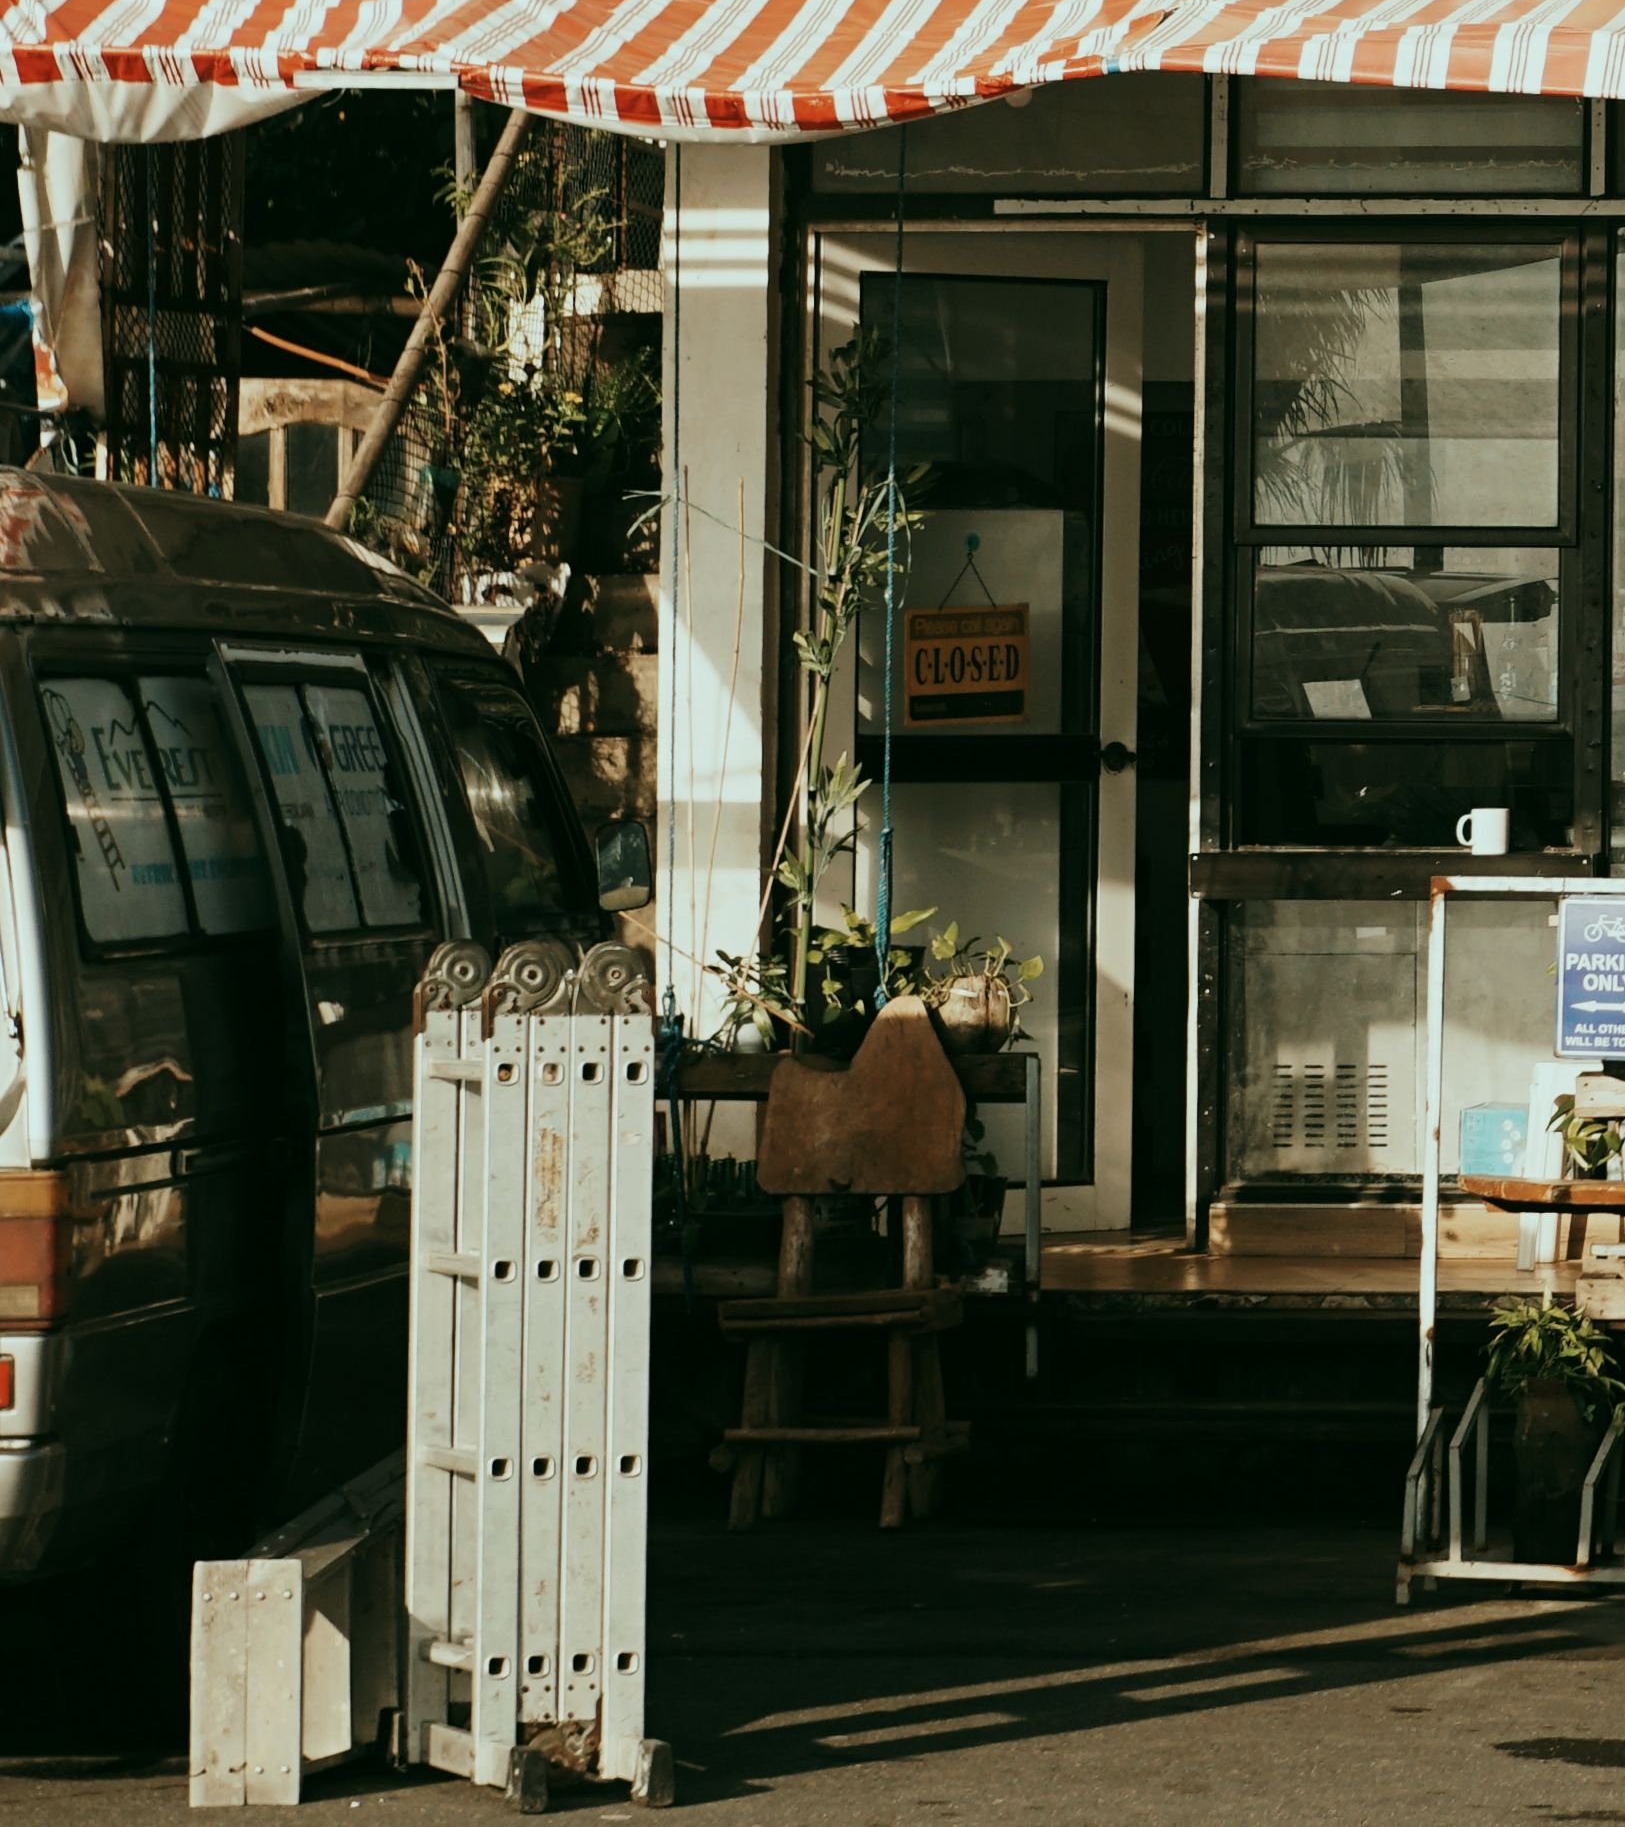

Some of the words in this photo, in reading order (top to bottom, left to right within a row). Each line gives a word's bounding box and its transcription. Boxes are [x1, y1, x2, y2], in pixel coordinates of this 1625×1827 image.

[1574, 1023, 1596, 1034] ALL
[1564, 1036, 1592, 1047] WILL
[1594, 1037, 1609, 1047] BE
